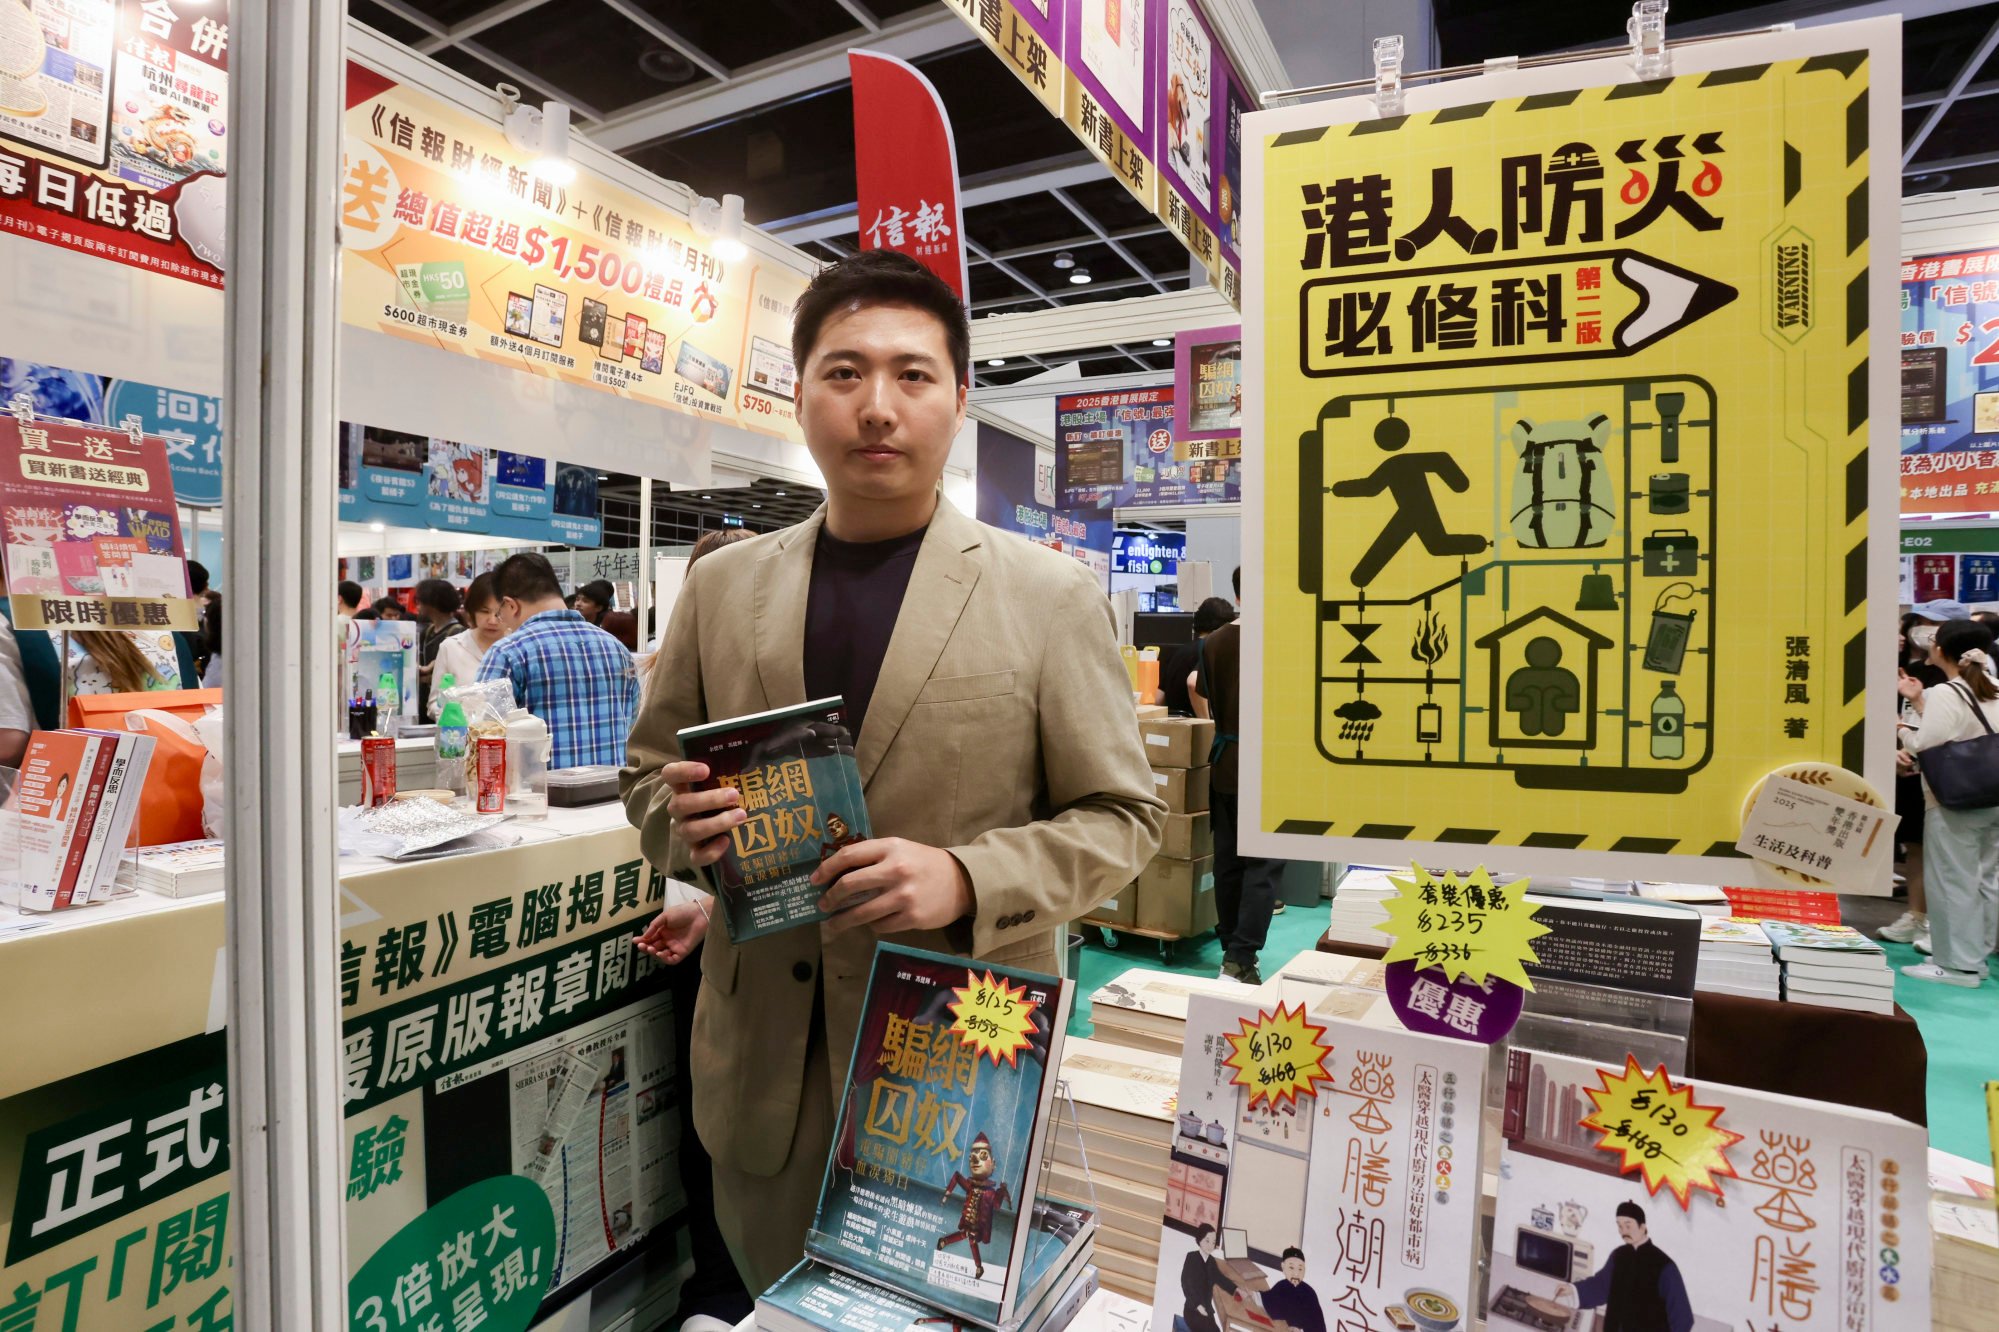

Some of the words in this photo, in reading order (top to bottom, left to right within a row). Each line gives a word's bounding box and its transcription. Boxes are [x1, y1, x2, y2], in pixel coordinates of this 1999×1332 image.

[141, 0, 229, 60] 合併
[141, 64, 219, 108] 杭州尋龍記
[1080, 92, 1144, 192] 新書上架
[0, 155, 173, 242] 每日低過
[343, 154, 389, 235] 送
[1300, 131, 1727, 271] 港人防災
[865, 199, 951, 249] 信報
[1168, 190, 1212, 262] 新書上架
[391, 185, 685, 308] 總值超過$1,500禮品
[422, 270, 466, 291] HK$50
[1783, 244, 1801, 329] WARNING
[1325, 273, 1568, 359] 必修科
[1575, 266, 1603, 345] 第二版
[490, 335, 576, 368] 額外送4個月訂閱服務
[674, 382, 696, 396] EJFQ
[1199, 361, 1234, 381] 騙網
[1199, 381, 1233, 398] 囚奴
[743, 394, 772, 415] $750
[1060, 411, 1107, 427] 港股主場
[1076, 392, 1159, 409] 2025香港書展限定
[18, 424, 141, 461] 買一送一
[1150, 432, 1168, 451] 送
[1188, 440, 1241, 458] 新書上
[1900, 451, 1999, 476] 成為小小香
[1909, 483, 1968, 500] 本地出品
[1127, 543, 1179, 560] enlighten
[1127, 559, 1149, 573] fish
[41, 598, 172, 626] 限時優惠
[1784, 636, 1811, 704] 張清風
[1784, 717, 1809, 739] 著
[106, 758, 126, 794] 學而反思
[717, 757, 815, 813] 騙網
[1773, 796, 1797, 811] 2025
[731, 803, 823, 859] 囚奴
[1752, 834, 1833, 870] 生活及科普
[1417, 909, 1487, 934] $235
[975, 987, 1017, 1016] $125
[1405, 976, 1488, 1036] 優惠
[877, 1011, 980, 1095] 騙網
[1248, 1030, 1292, 1062] $130
[440, 1073, 465, 1090] 信報
[863, 1077, 968, 1163] 囚奴
[1630, 1088, 1689, 1138] $130
[31, 1082, 225, 1238] 正式
[345, 1114, 409, 1203] 驗
[1405, 1070, 1433, 1265] 太醫穿越現代廚房治好都市病
[355, 1203, 518, 1332] 3倍放大
